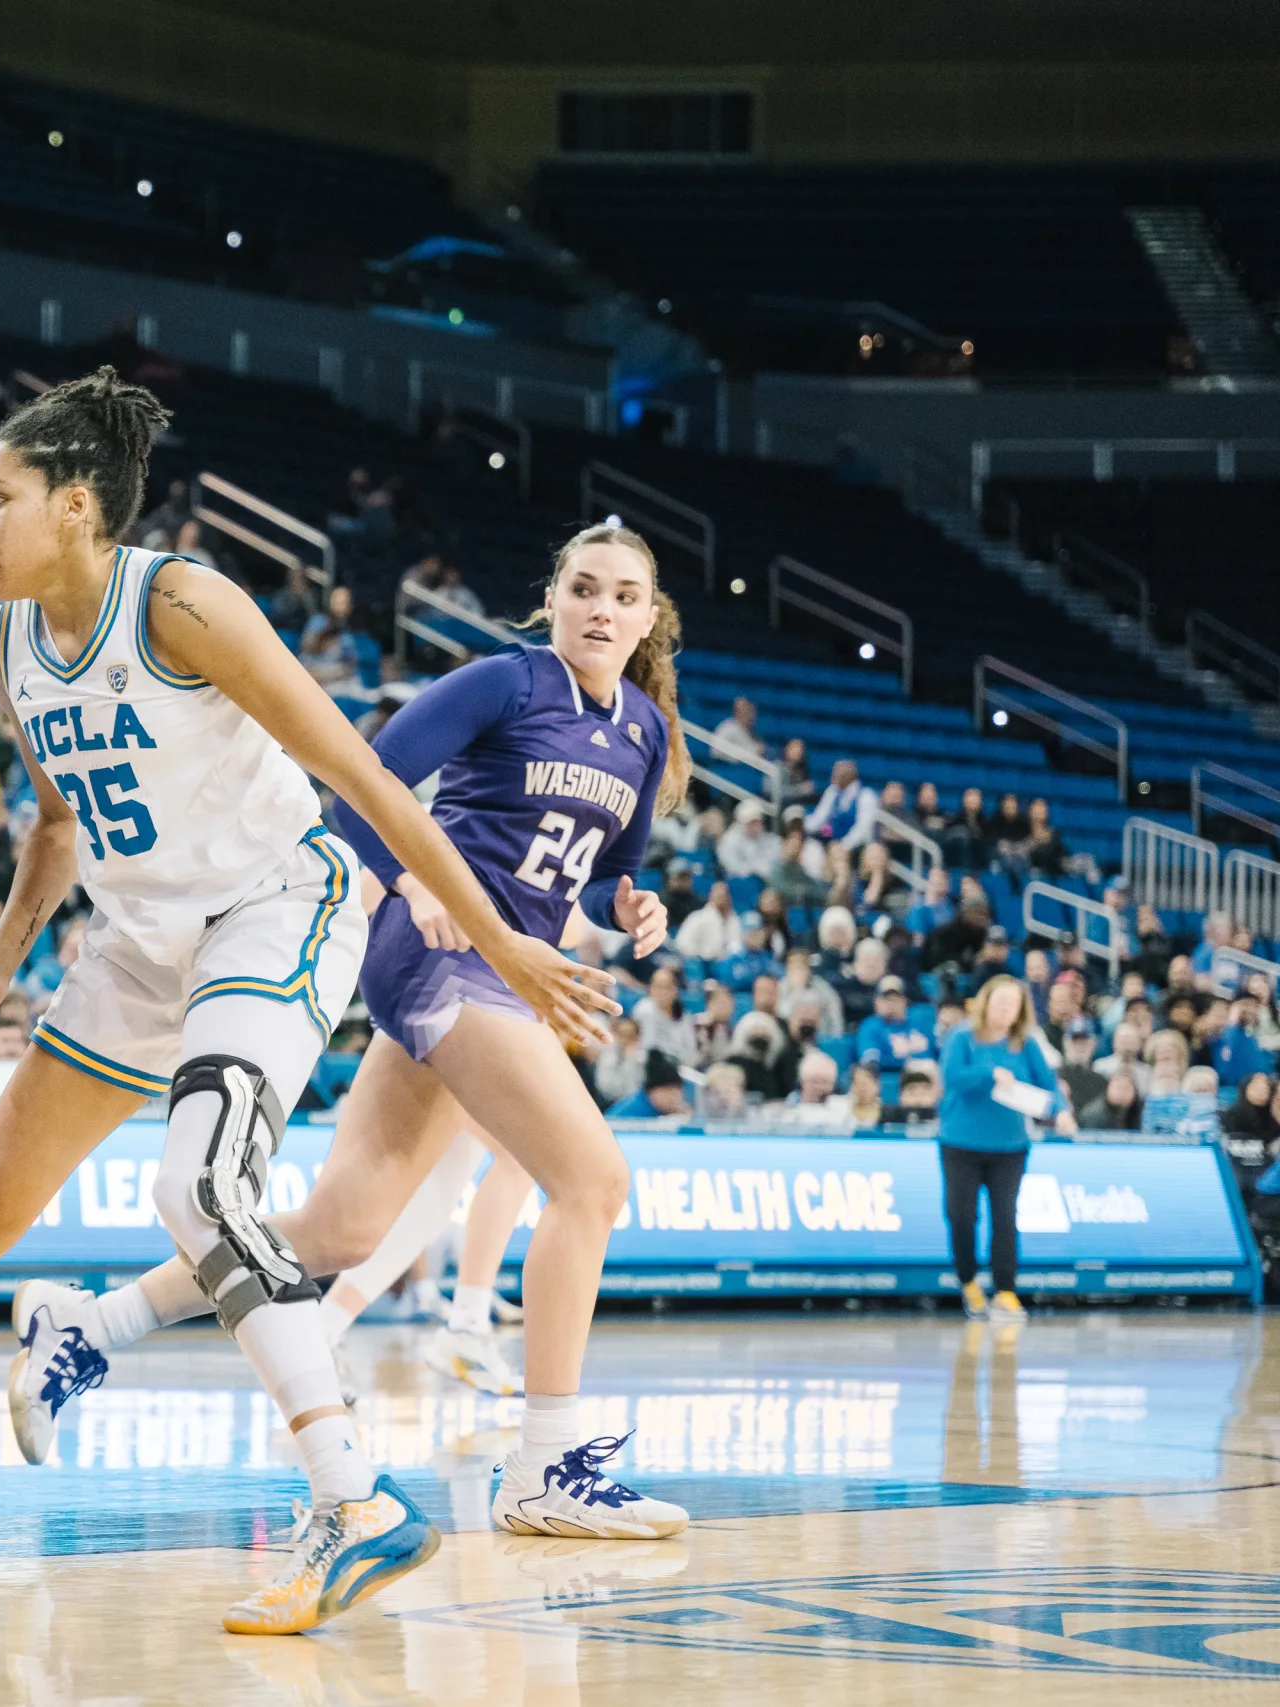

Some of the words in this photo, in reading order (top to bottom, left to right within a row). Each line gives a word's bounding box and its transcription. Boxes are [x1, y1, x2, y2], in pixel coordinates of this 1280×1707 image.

[23, 703, 158, 764] UCLA
[514, 810, 605, 902] 24
[634, 1168, 792, 1231] HEALTH
